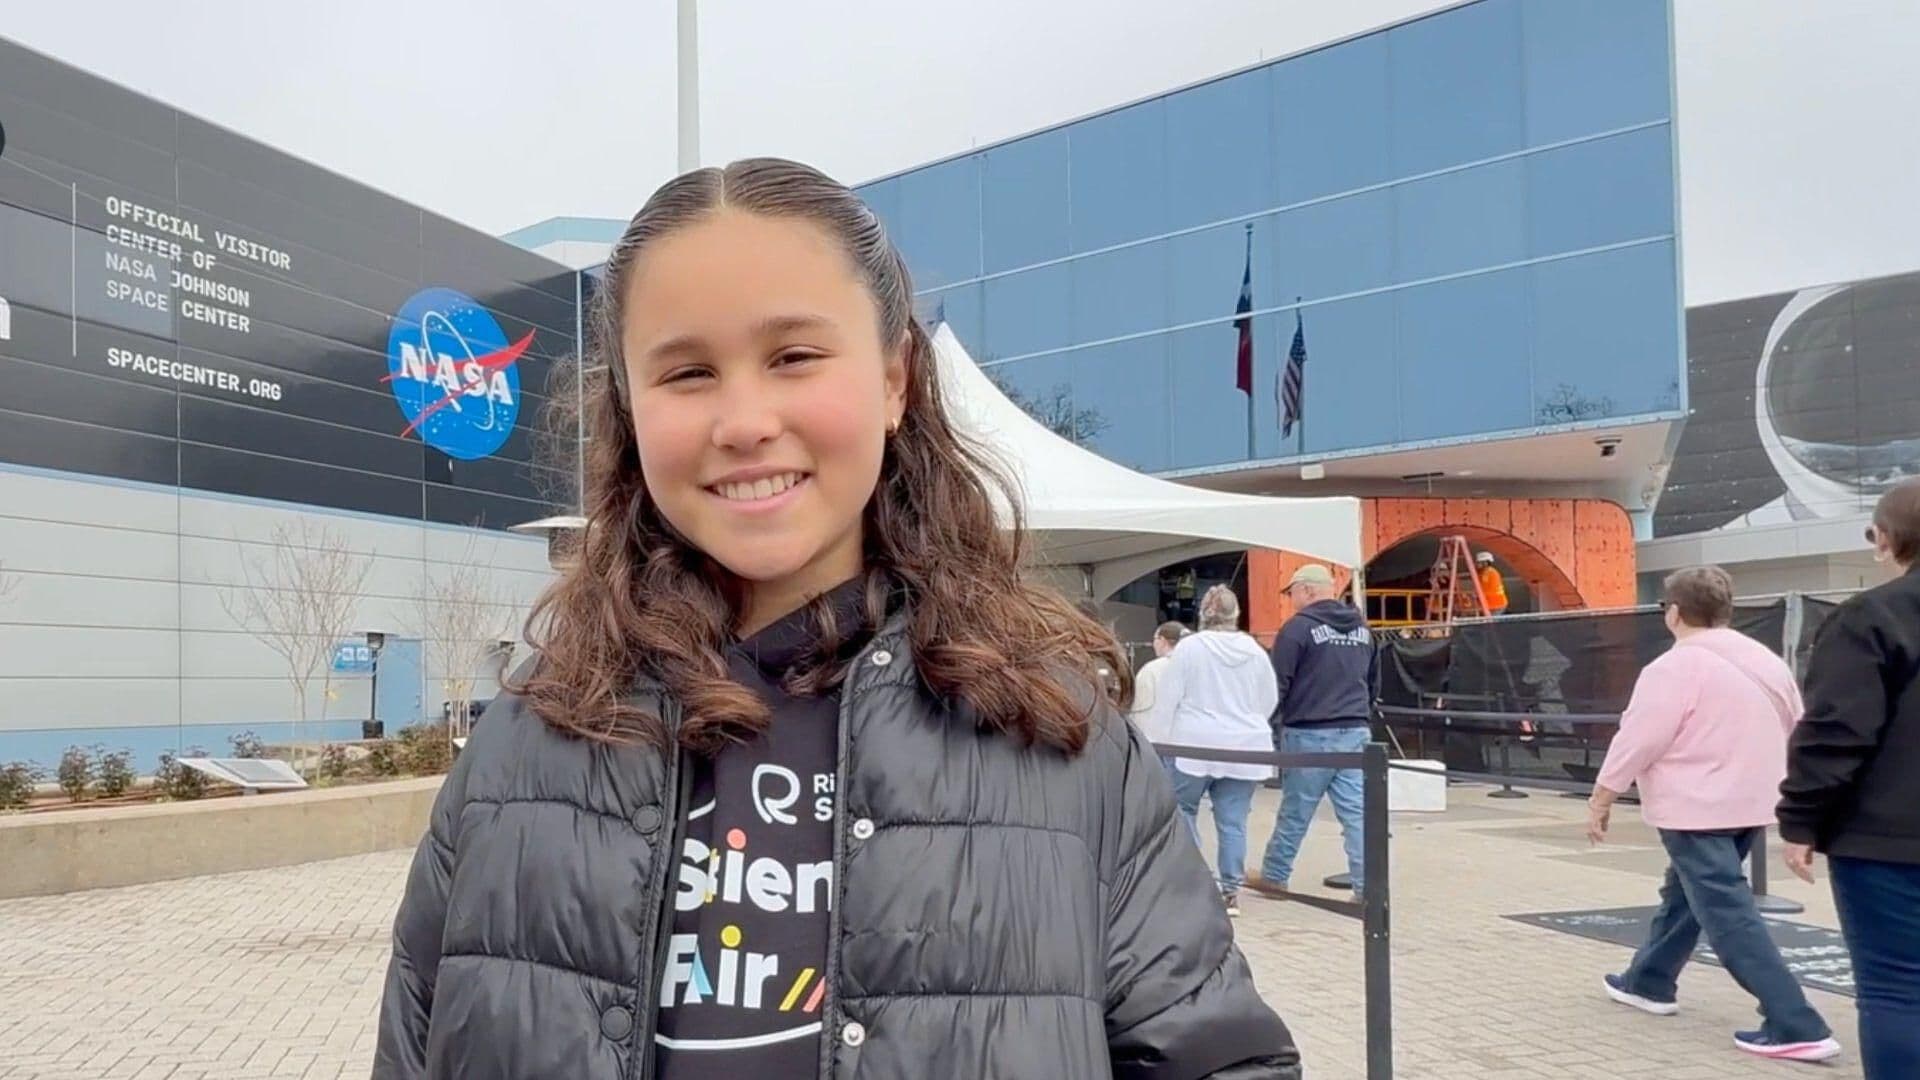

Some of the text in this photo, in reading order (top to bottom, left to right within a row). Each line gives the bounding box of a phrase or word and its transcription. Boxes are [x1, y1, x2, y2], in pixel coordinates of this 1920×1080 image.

[106, 196, 291, 271] OFFICIAL VISITOR
[106, 224, 217, 271] CENTER OF
[105, 252, 250, 308] NASA JOHNSON
[106, 280, 250, 333] SPACE CENTER
[107, 347, 282, 401] SPACECENTER.ORG
[399, 341, 514, 405] NASA
